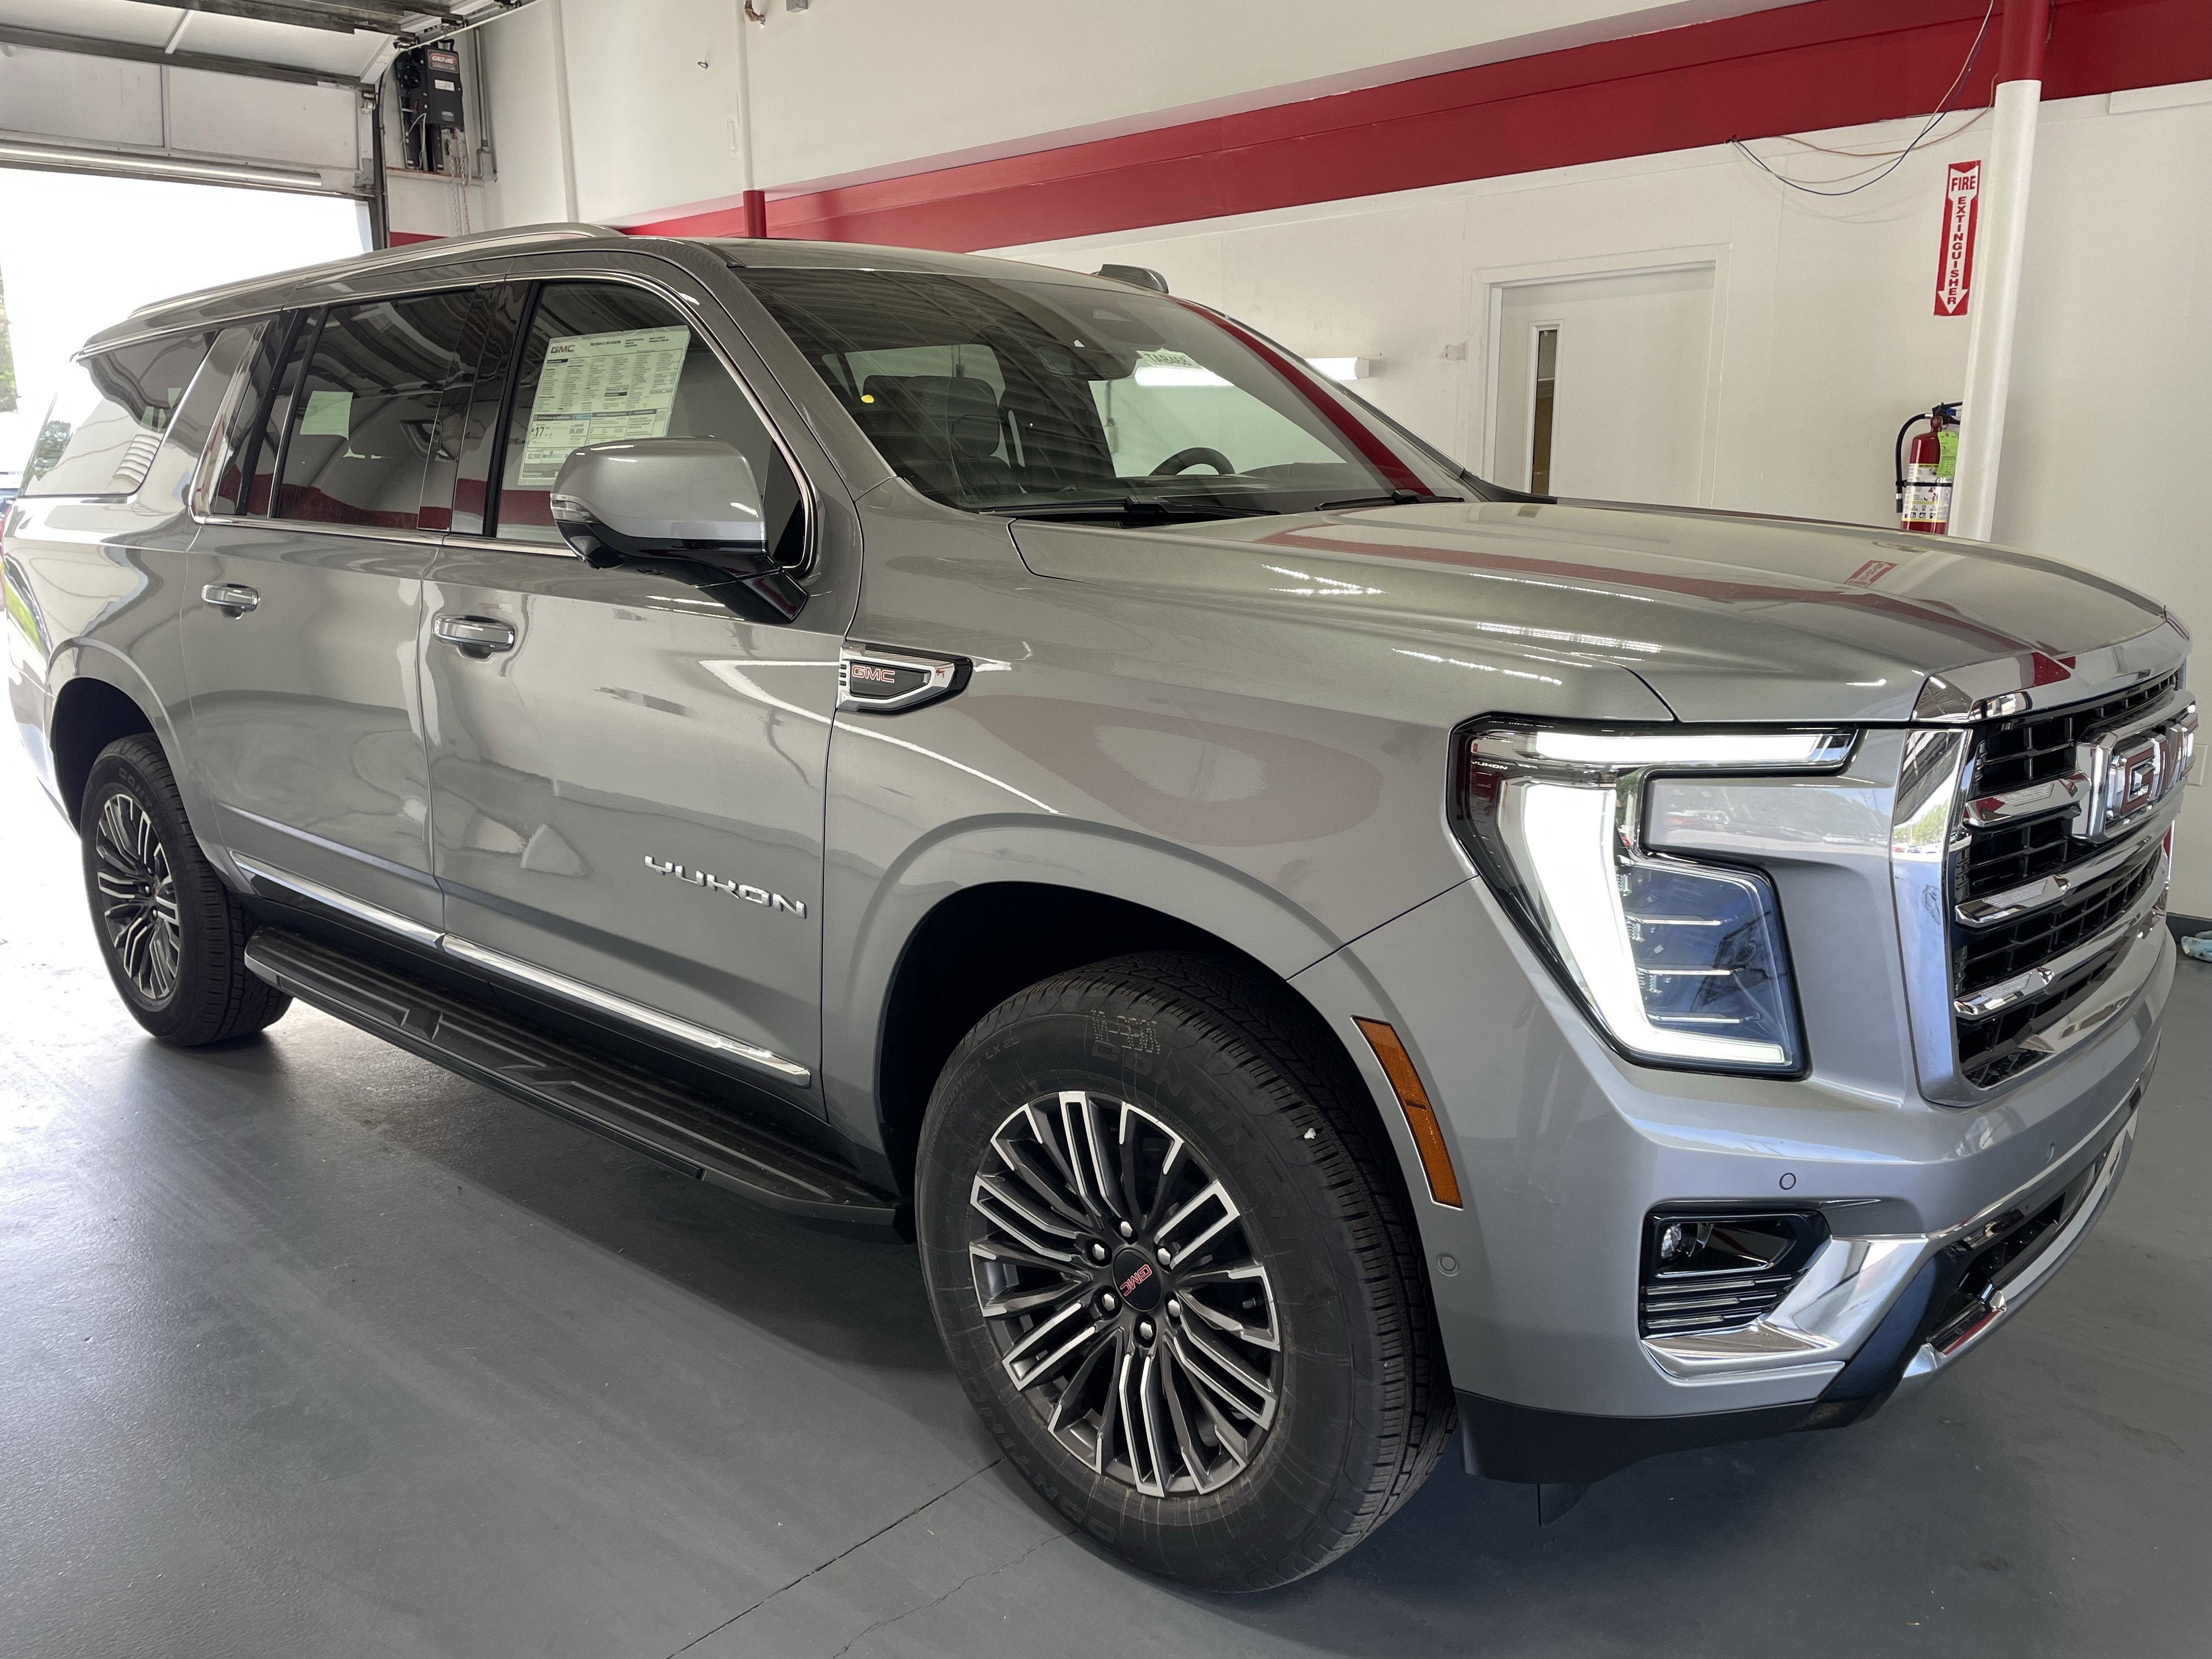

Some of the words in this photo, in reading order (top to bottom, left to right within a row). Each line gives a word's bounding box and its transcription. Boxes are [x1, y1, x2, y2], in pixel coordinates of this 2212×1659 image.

[1951, 175, 1976, 191] FIRE
[1947, 196, 1967, 304] EXTINGUISHER
[550, 345, 576, 354] GMC
[535, 426, 544, 437] 17
[851, 665, 895, 683] GMC
[1471, 761, 1508, 770] YUKON
[645, 855, 807, 919] YUKON
[1120, 1264, 1153, 1296] GMC
